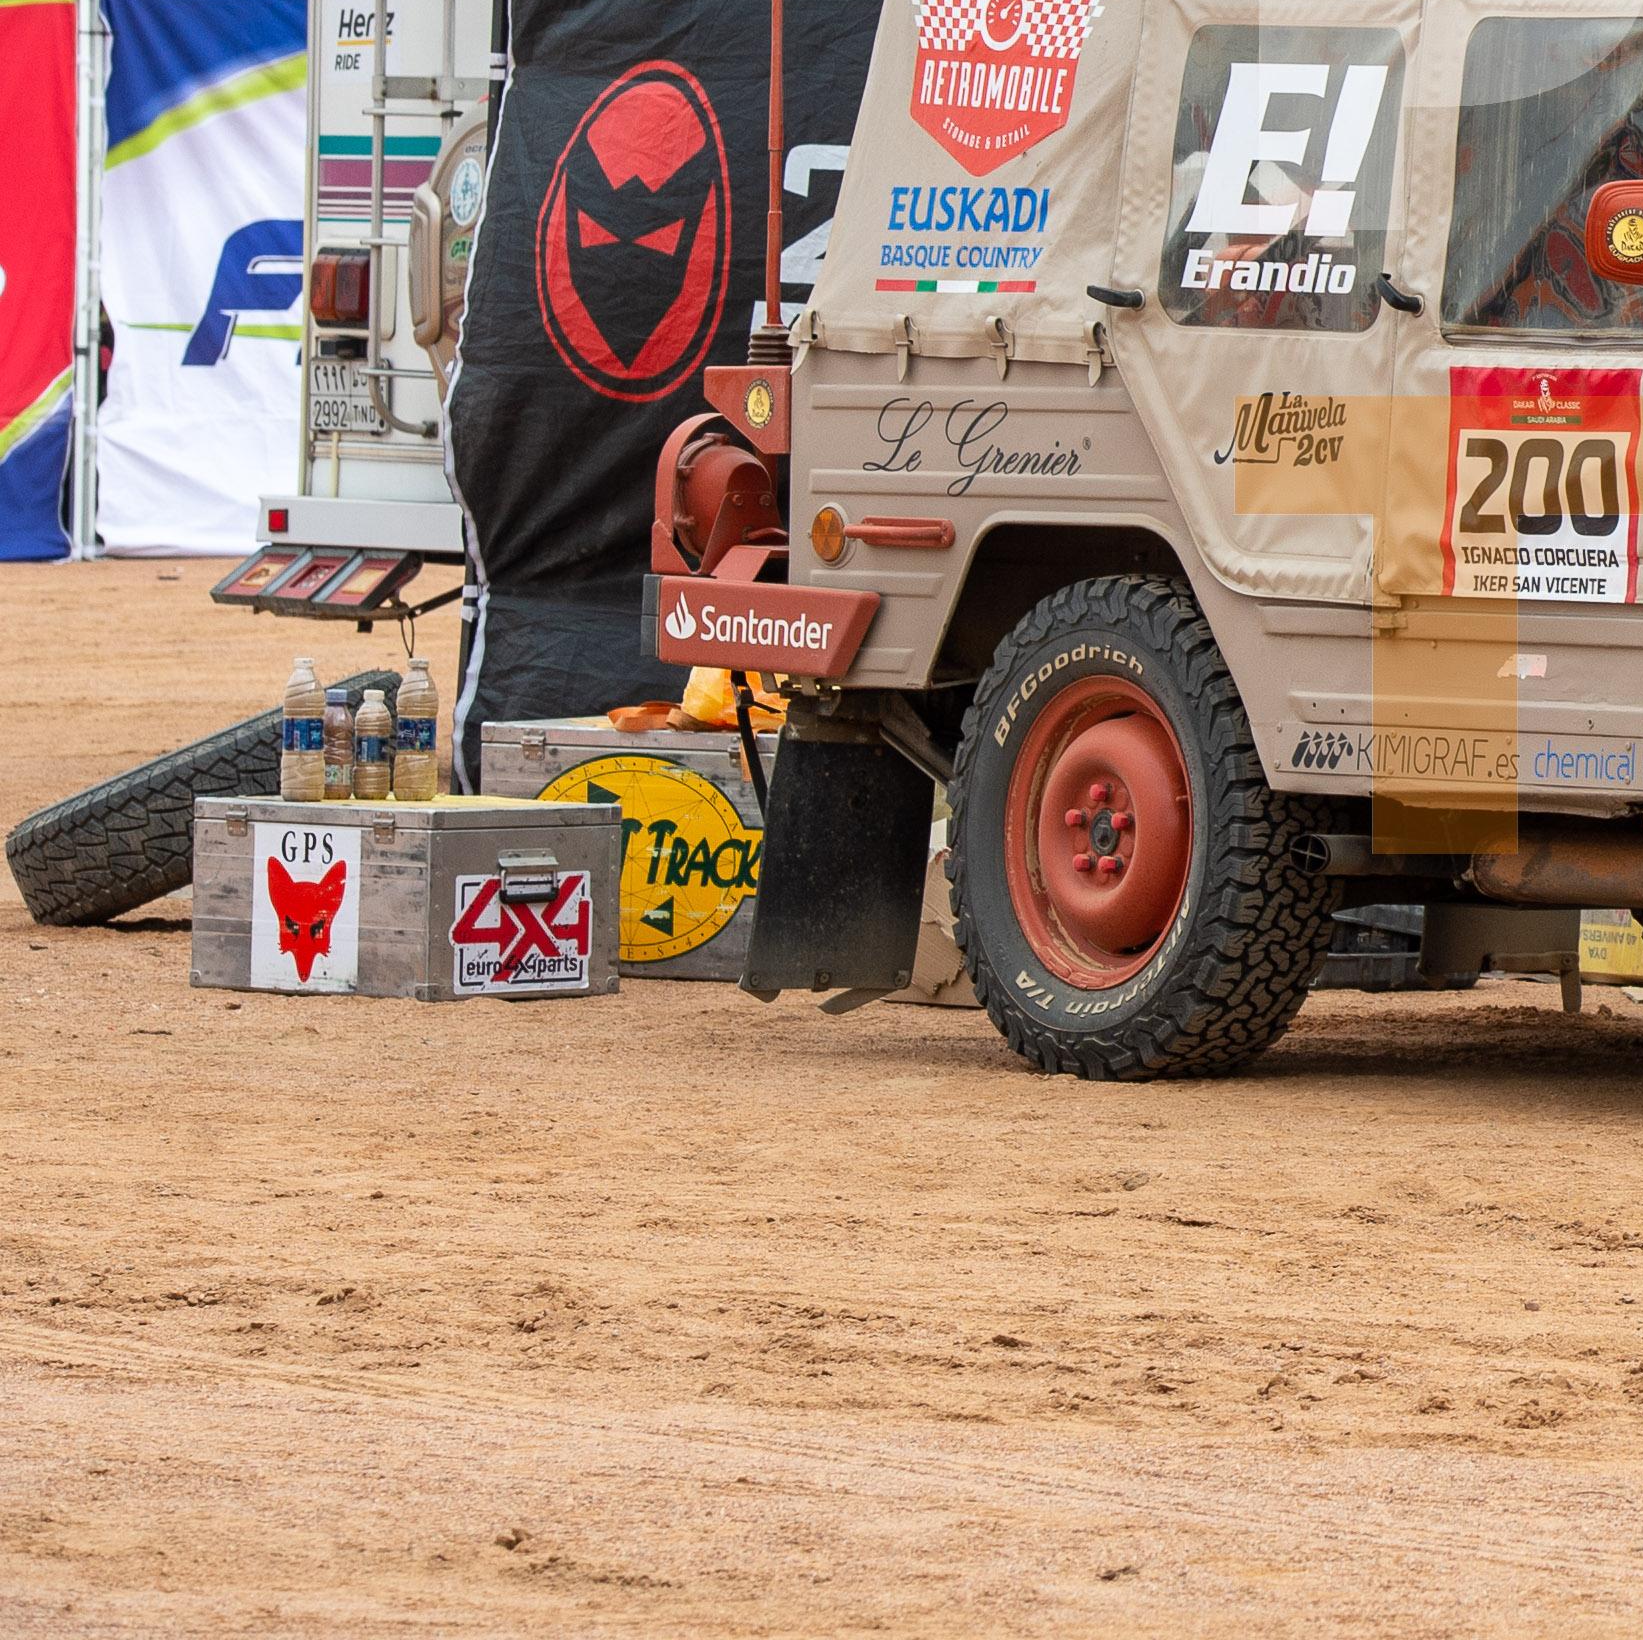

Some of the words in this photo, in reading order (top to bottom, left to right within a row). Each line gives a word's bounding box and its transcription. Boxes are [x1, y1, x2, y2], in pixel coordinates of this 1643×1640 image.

[338, 8, 395, 38] Herz
[335, 53, 361, 71] RIDE
[920, 60, 1068, 114] RETROMOBILE
[942, 117, 981, 149] STORAGE
[995, 124, 1030, 149] DETAIL
[1184, 62, 1389, 237] E!
[887, 186, 1050, 233] EUSKADI
[880, 244, 952, 268] BASQUE
[955, 244, 1043, 268] COUNTRY
[1180, 249, 1356, 295] Erandio
[314, 400, 348, 427] 2992
[862, 398, 934, 472] Le
[1459, 437, 1620, 536] 200
[1462, 545, 1532, 567] IGNACIO
[1535, 547, 1619, 568] CORCUERA
[1473, 575, 1509, 593] IKER
[1512, 576, 1543, 594] SAN
[1546, 577, 1606, 595] VICENTE
[701, 605, 832, 650] Santander
[993, 643, 1145, 747] BFGoodrich
[1356, 732, 1520, 780] KIMIGRAF.es
[1534, 738, 1635, 782] chemical
[280, 830, 336, 865] GPS
[1583, 929, 1625, 945] ANIVERS
